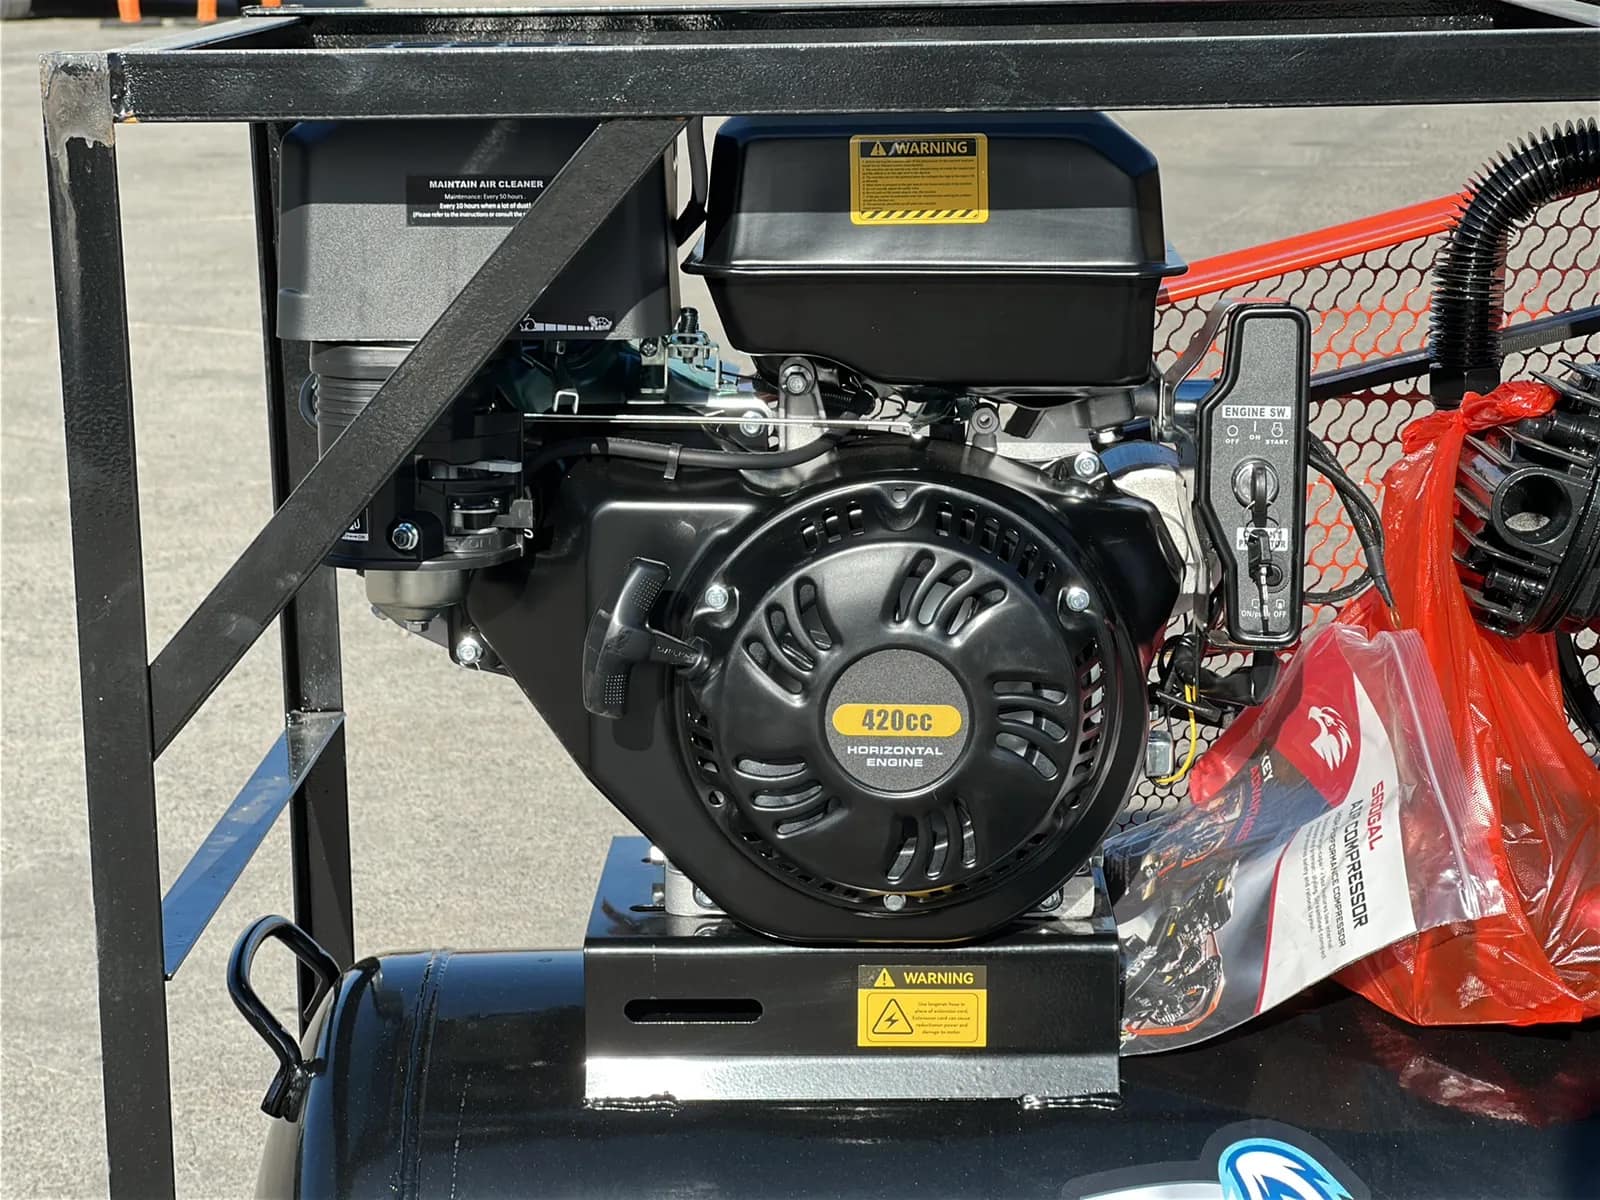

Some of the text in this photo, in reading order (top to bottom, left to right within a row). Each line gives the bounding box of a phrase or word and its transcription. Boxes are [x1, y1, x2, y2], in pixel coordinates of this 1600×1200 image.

[895, 140, 968, 154] WARNING
[429, 180, 544, 188] MAINTAIN AIR CLEANER
[439, 202, 455, 210] Every
[1225, 406, 1289, 418] ENGINE SW.
[1273, 610, 1287, 618] OFF
[862, 709, 932, 731] 420cc
[847, 745, 943, 756] HORIZONTAL
[866, 758, 924, 767] ENGINE
[1344, 820, 1368, 929] COMPRESSOR
[1332, 885, 1346, 948] COMPRESSOR
[903, 971, 974, 985] WARNING
